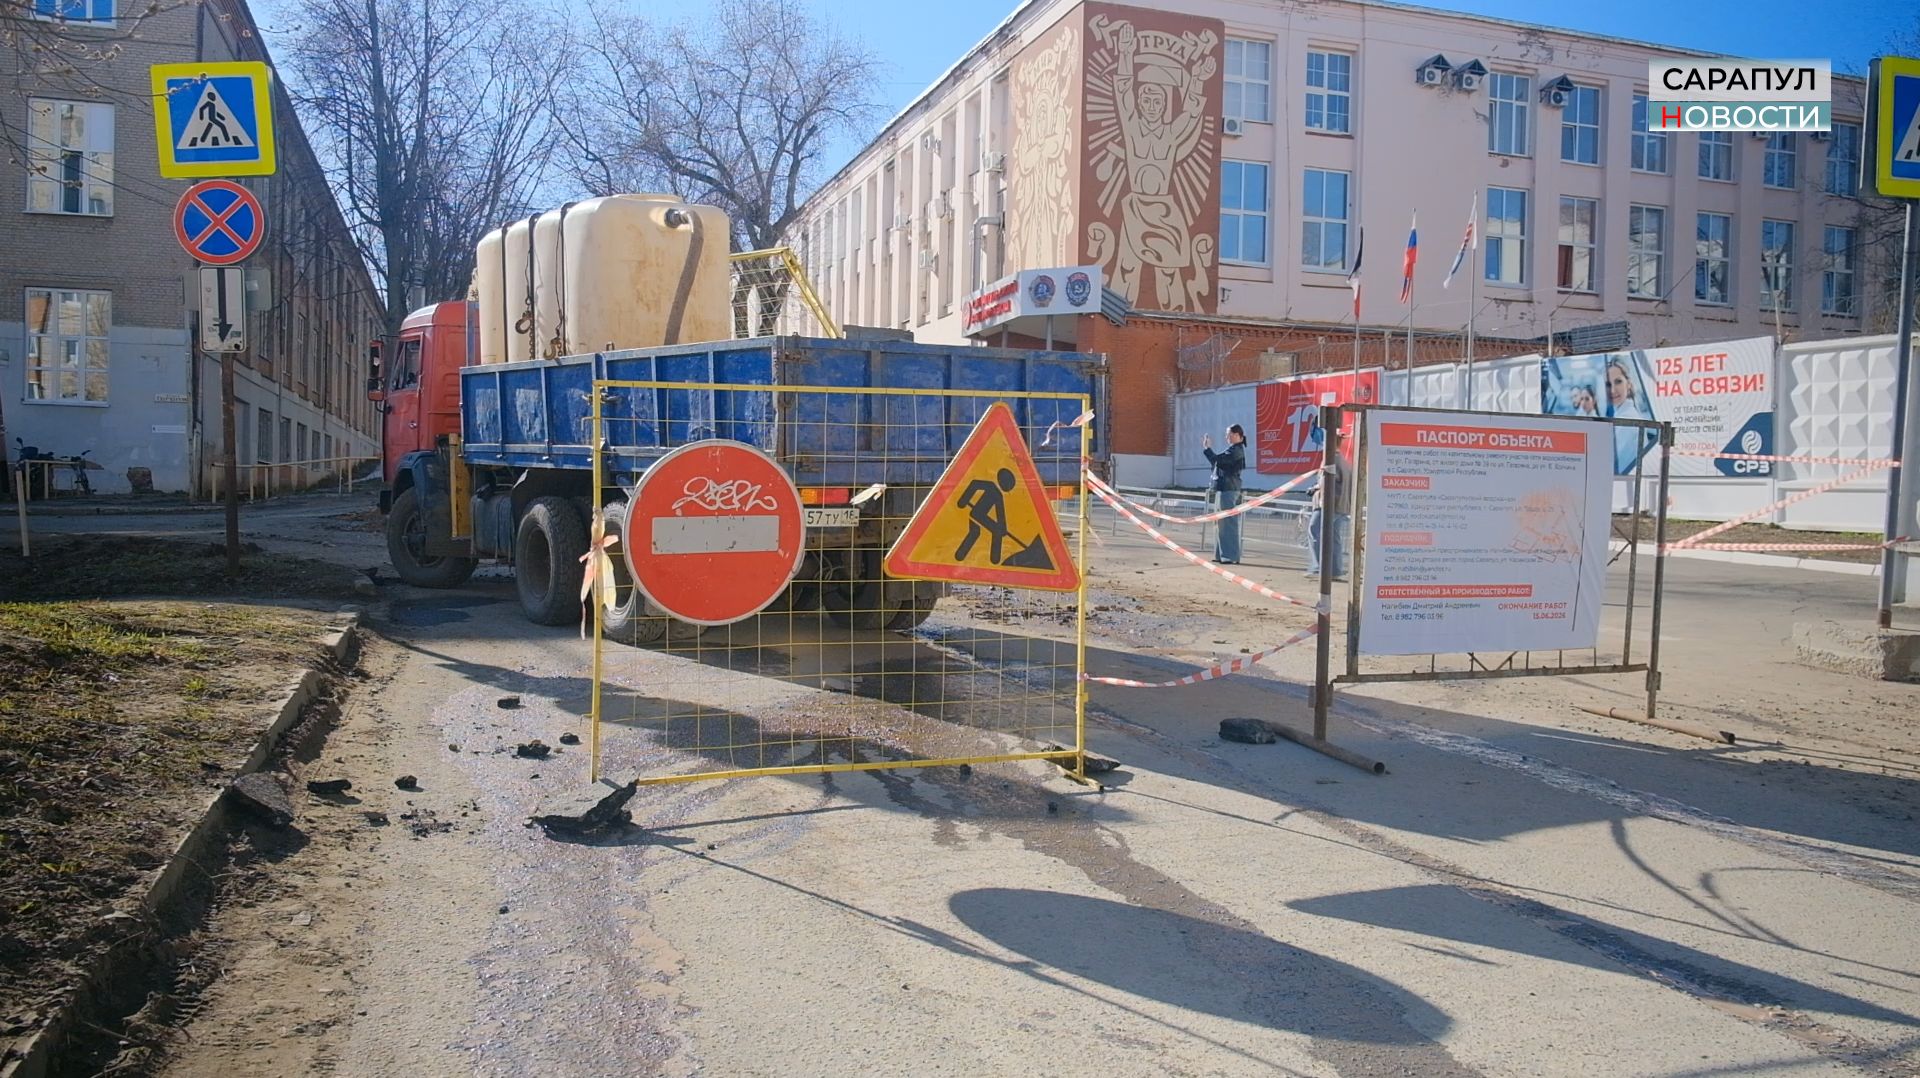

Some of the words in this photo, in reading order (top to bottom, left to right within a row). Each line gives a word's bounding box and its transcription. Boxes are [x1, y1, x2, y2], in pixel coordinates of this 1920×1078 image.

[1140, 35, 1186, 60] ТРУД
[1655, 357, 1683, 376] 125
[1688, 353, 1728, 373] ЛЕТ
[1656, 380, 1684, 398] НА
[1689, 374, 1765, 396] СВЯЗИ!
[1416, 429, 1485, 446] ПАСПОРТ
[1488, 433, 1553, 449] ОБЪЕКТА
[1733, 459, 1770, 474] СРЗ
[1383, 478, 1428, 488] ЗАКАЗЧИК:
[807, 510, 823, 525] 57
[1378, 588, 1441, 597] ОТВЕТСТВЕННЫЙ
[1441, 588, 1451, 596] ЗА
[1497, 602, 1543, 611] ОКОНЧАНИЕ
[1543, 601, 1568, 610] РАБОТ
